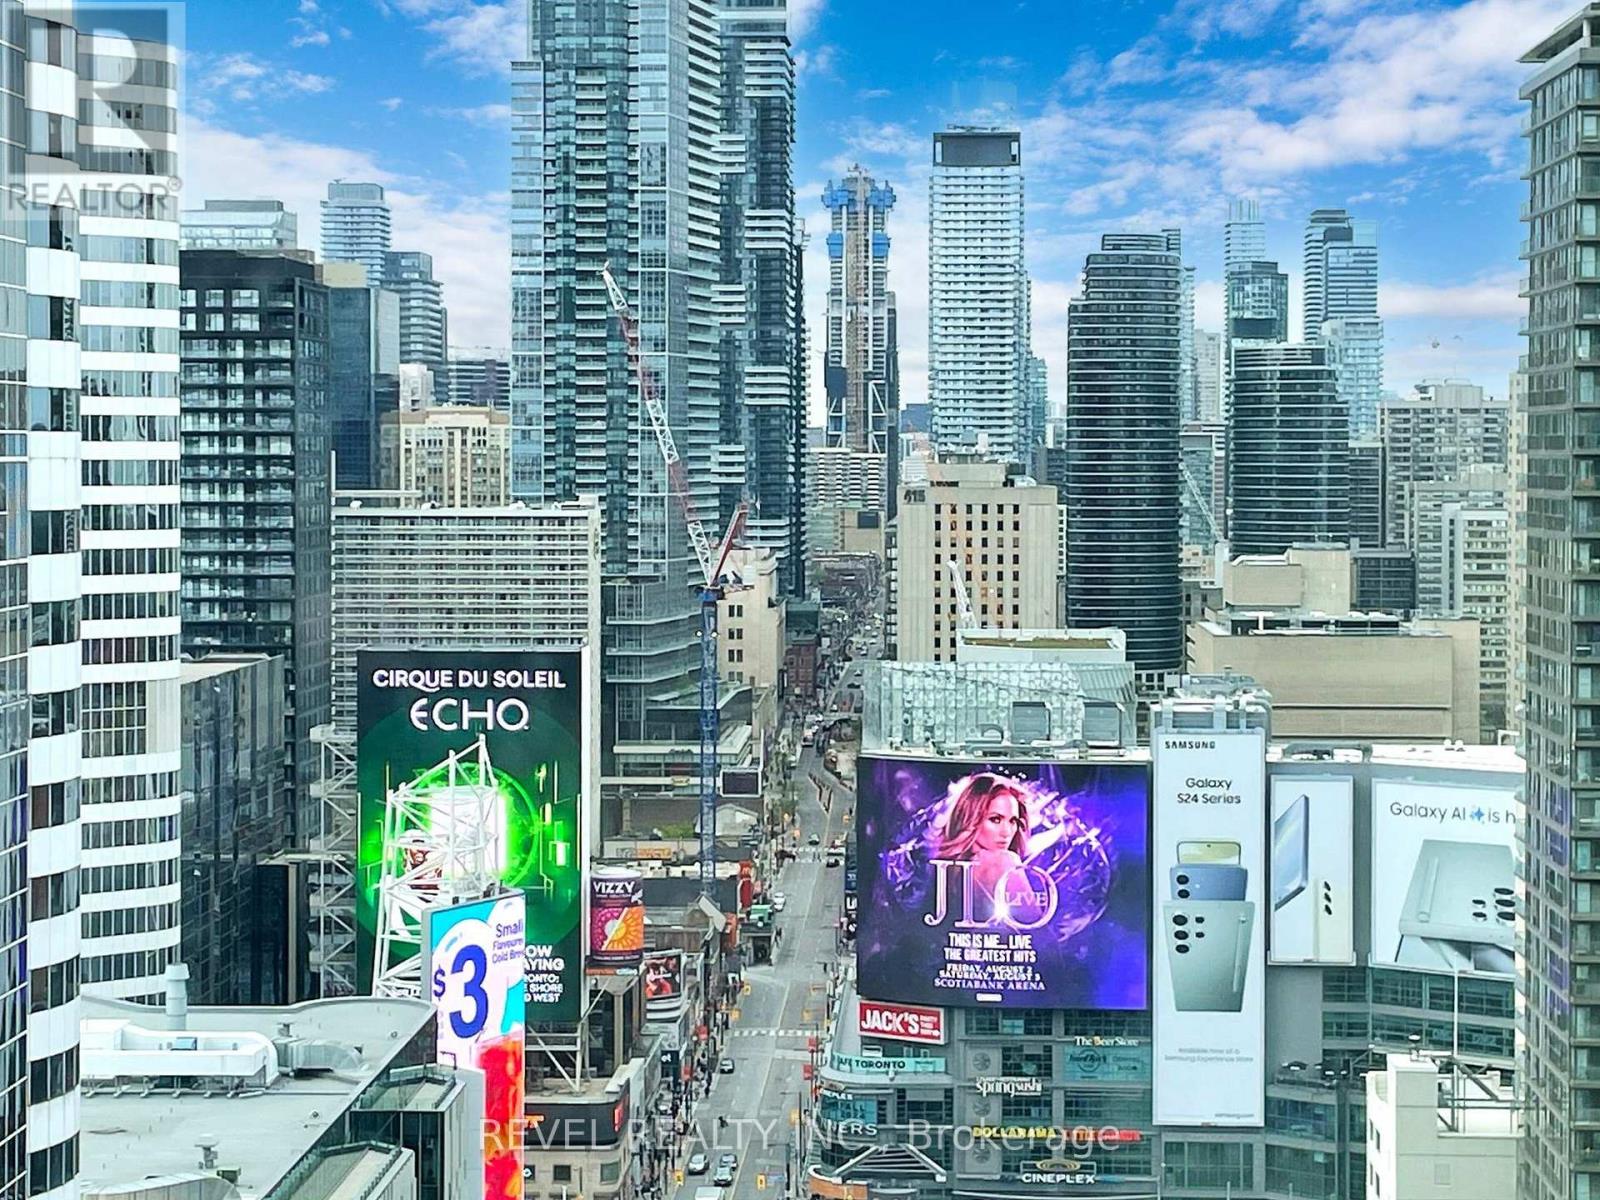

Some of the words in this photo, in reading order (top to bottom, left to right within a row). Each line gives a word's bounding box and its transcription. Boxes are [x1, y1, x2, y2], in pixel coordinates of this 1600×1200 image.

[372, 669, 453, 692] CIRQUE
[458, 670, 487, 687] DU
[493, 670, 567, 688] SOLEIL
[410, 697, 529, 731] ECHO
[1165, 740, 1216, 749] SAMSUNG
[1185, 777, 1232, 790] Galaxy
[1177, 793, 1199, 803] S24
[1201, 793, 1241, 804] Series
[1390, 801, 1447, 824] Galaxy
[1452, 807, 1466, 820] AI
[1488, 807, 1500, 823] is
[593, 881, 635, 893] VIZZY
[923, 859, 1059, 930] JLO
[495, 918, 523, 938] Small
[949, 933, 971, 947] THIS
[972, 934, 983, 948] IS
[1009, 935, 1032, 949] LIVE
[525, 944, 552, 957] OW
[944, 948, 962, 960] THE
[964, 949, 1011, 962] GREATEST
[1013, 950, 1036, 962] HITS
[934, 978, 1004, 989] SCOTIABANK
[1008, 980, 1046, 990] ARENA
[433, 944, 489, 1039] $3
[860, 1009, 920, 1035] JACK'S
[1074, 1036, 1092, 1046] The
[855, 1060, 905, 1069] TORONTO
[1022, 1173, 1095, 1184] CINEPLEX
